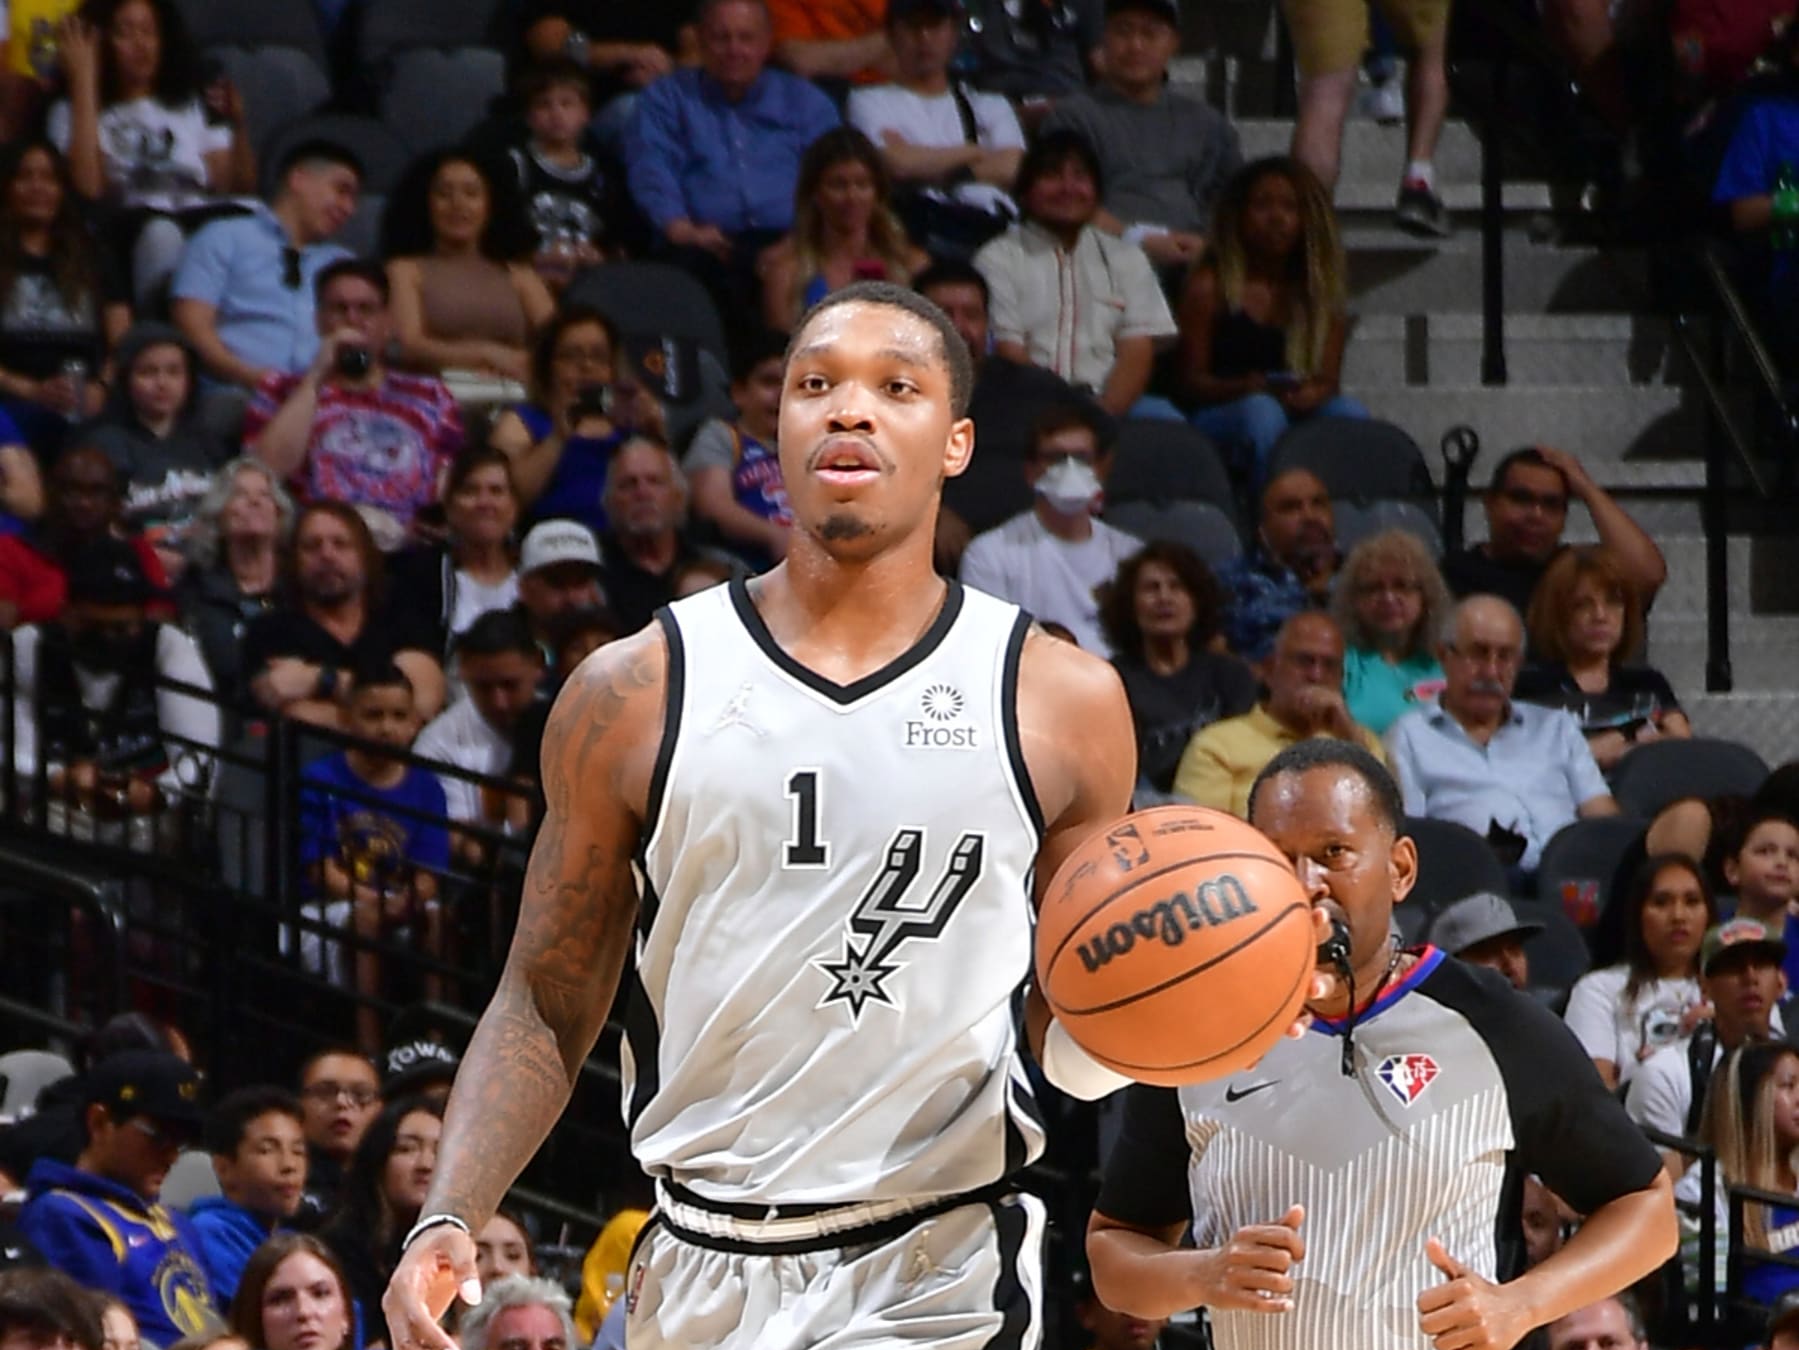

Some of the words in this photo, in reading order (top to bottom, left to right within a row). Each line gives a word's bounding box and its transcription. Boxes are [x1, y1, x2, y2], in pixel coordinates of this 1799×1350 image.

[905, 720, 978, 748] Frost
[785, 769, 829, 867] 1
[1075, 874, 1259, 974] Wilson
[388, 1040, 453, 1073] TOWN
